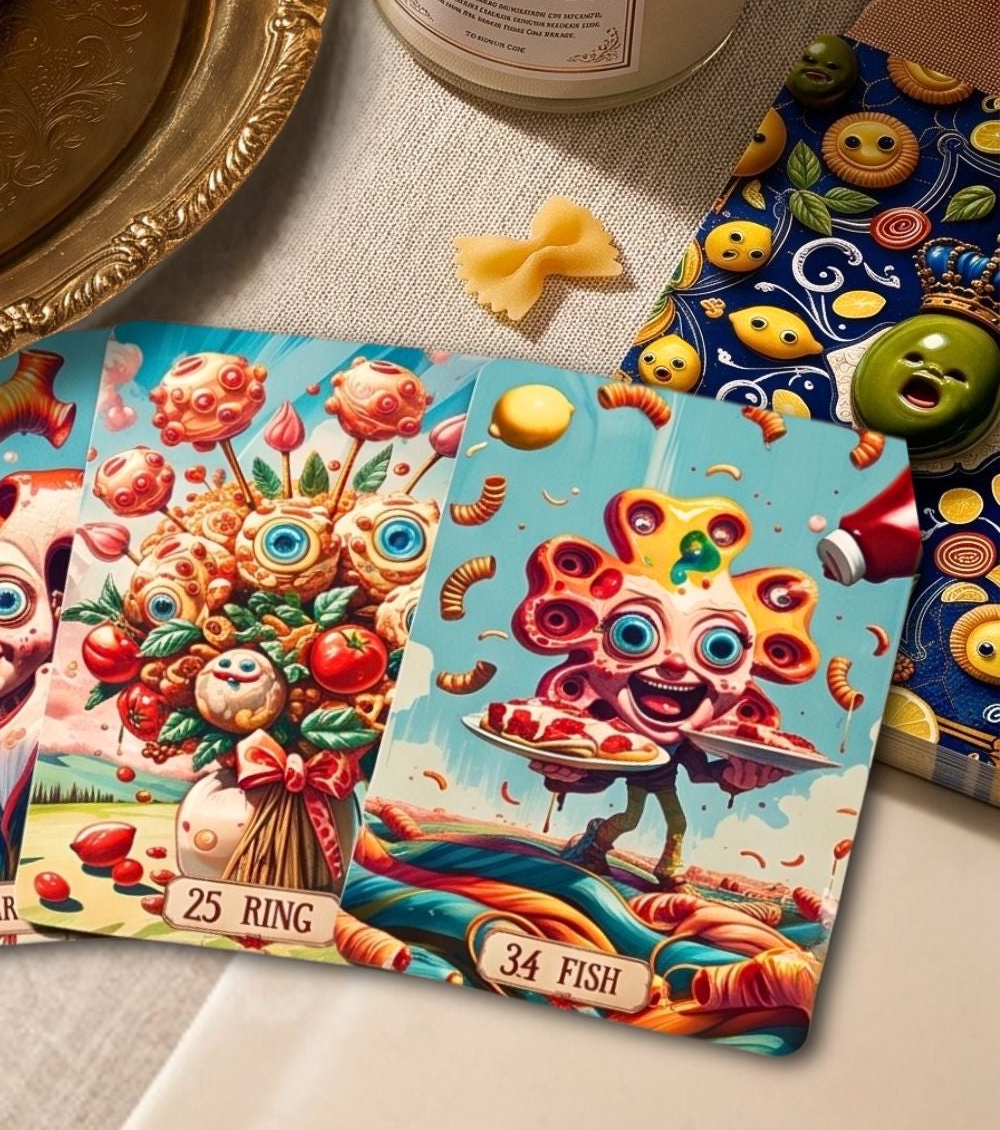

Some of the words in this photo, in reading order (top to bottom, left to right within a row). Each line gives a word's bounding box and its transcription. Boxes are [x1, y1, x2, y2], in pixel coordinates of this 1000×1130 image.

[182, 887, 222, 923] 25
[240, 896, 314, 934] RING
[499, 943, 543, 982] 34
[556, 956, 623, 996] FISH
